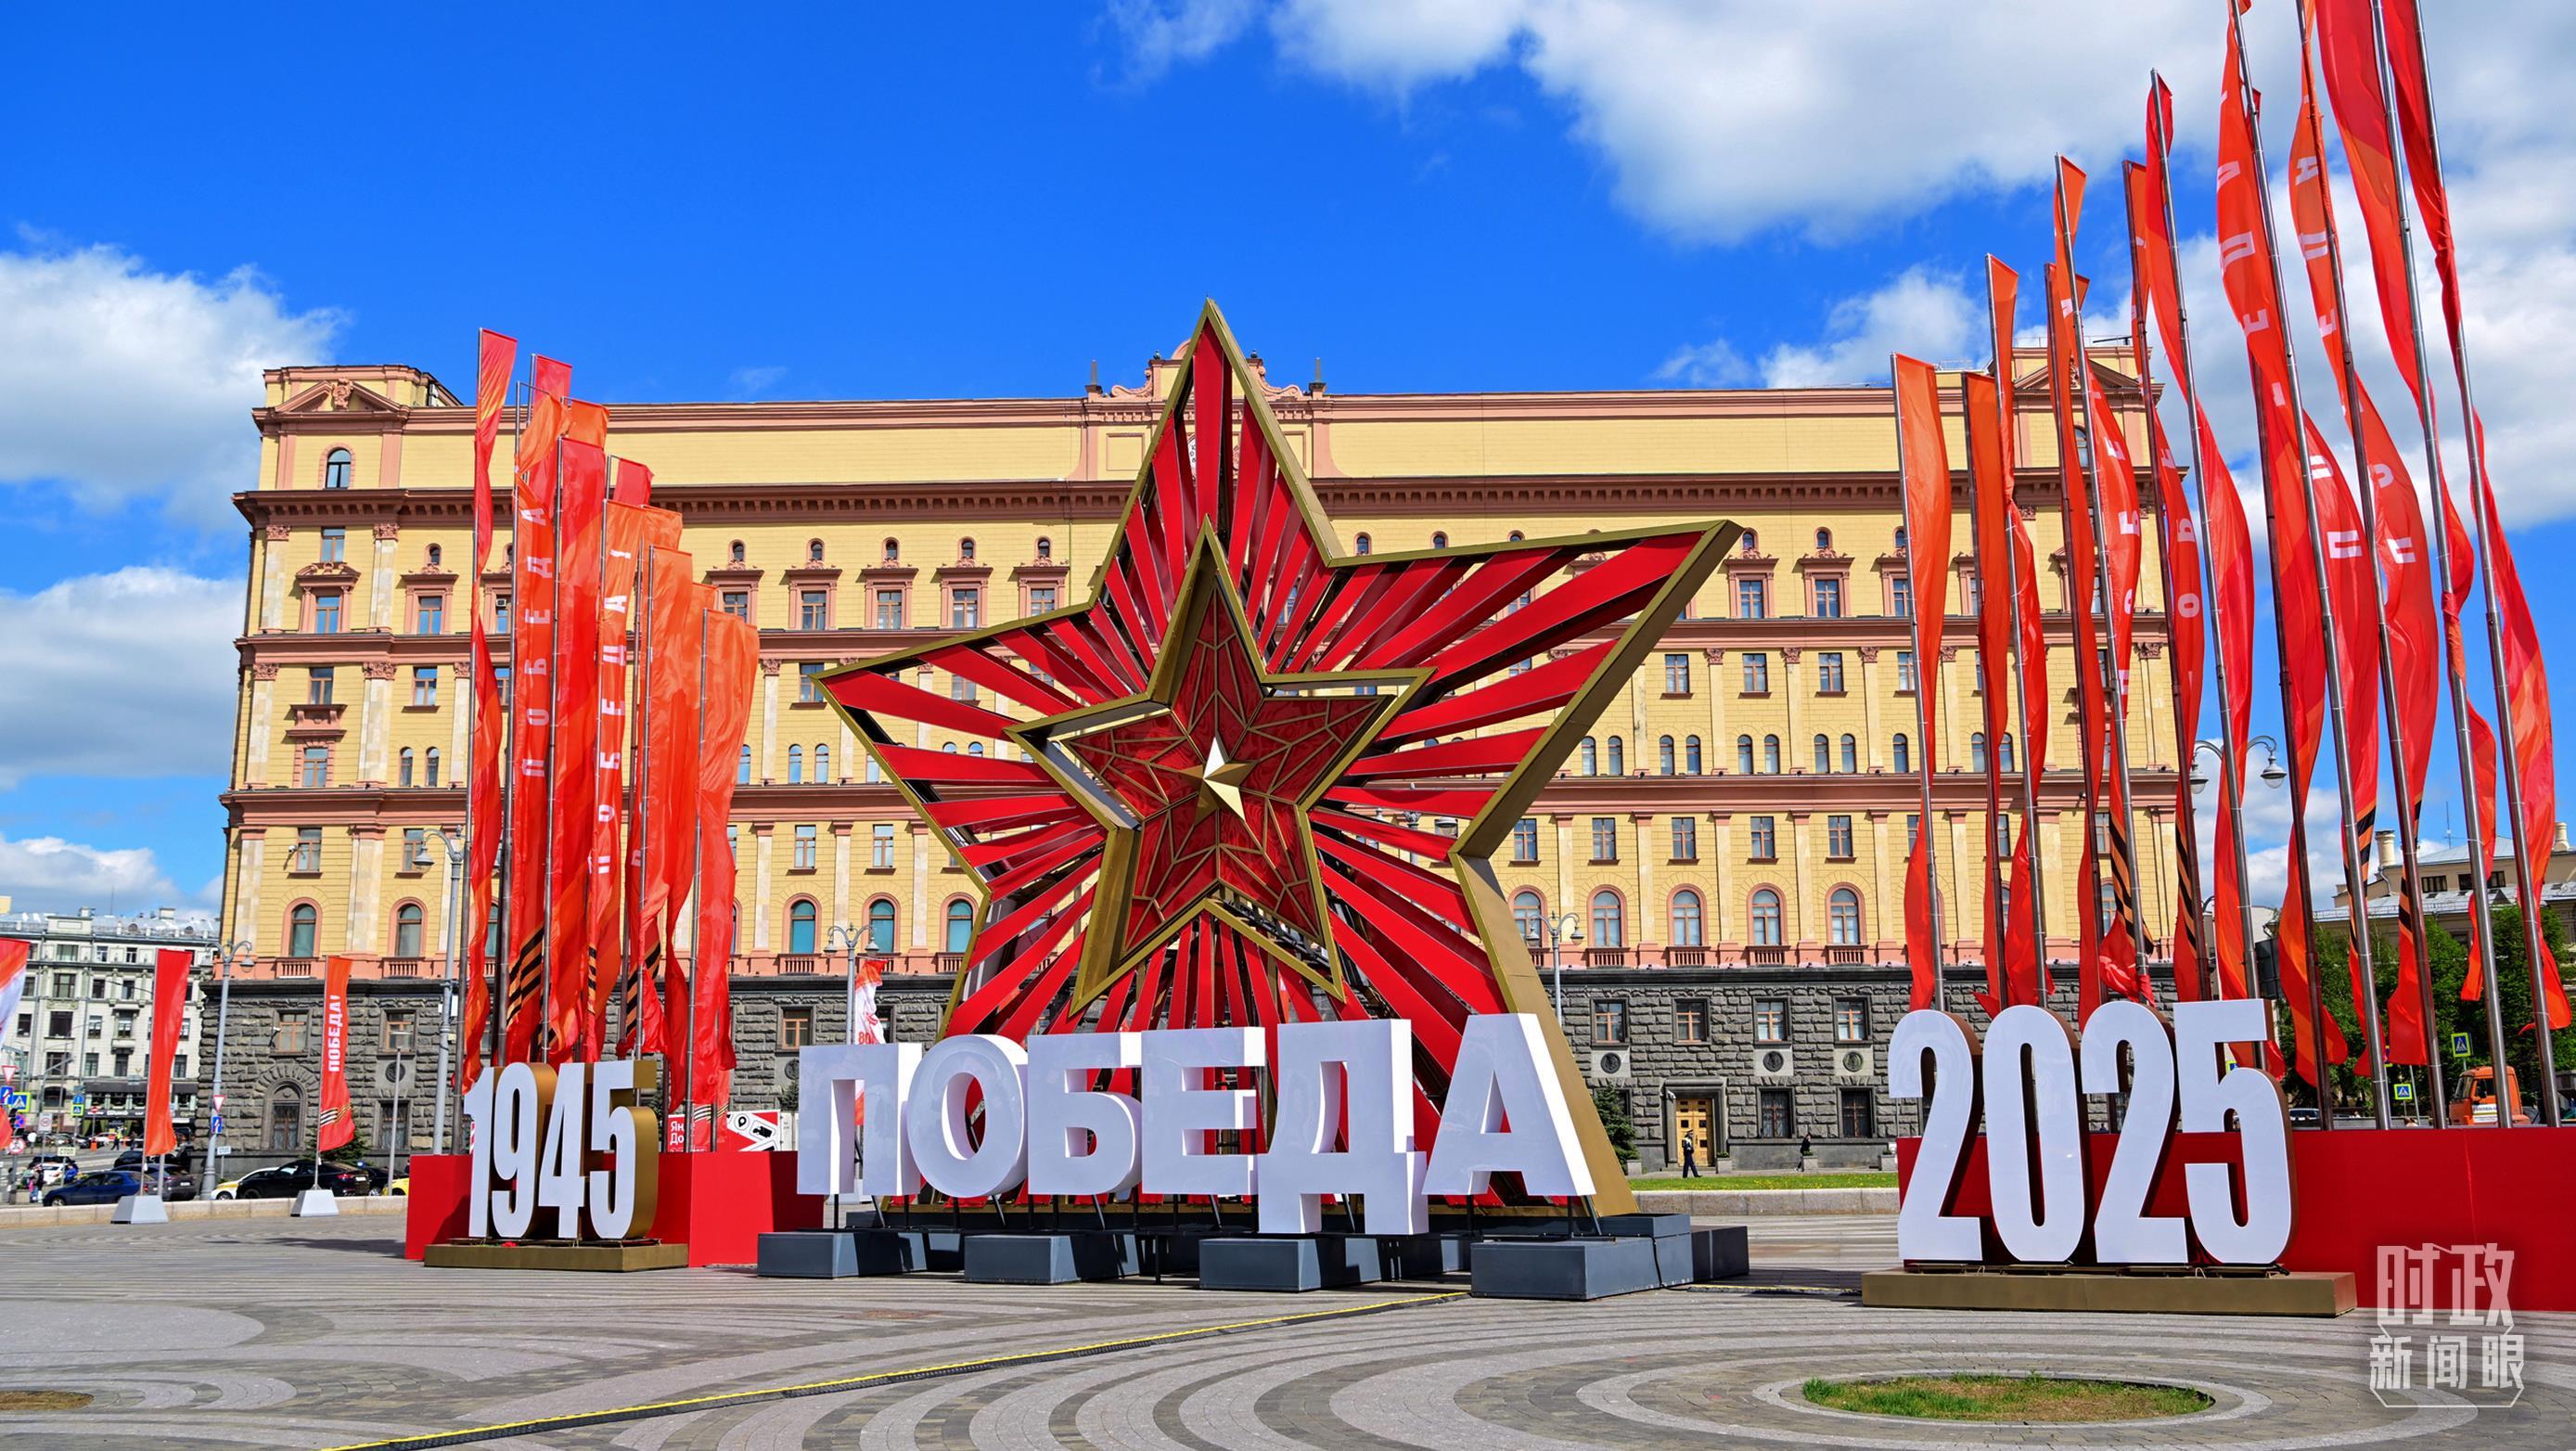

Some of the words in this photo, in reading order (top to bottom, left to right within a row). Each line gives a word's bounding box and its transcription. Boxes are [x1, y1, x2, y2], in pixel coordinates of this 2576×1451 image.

[327, 995, 343, 1072] ПОБЕДА!
[798, 1013, 1591, 1235] ПОБЕДА
[1889, 999, 2292, 1265] 2025
[464, 1060, 640, 1239] 1945
